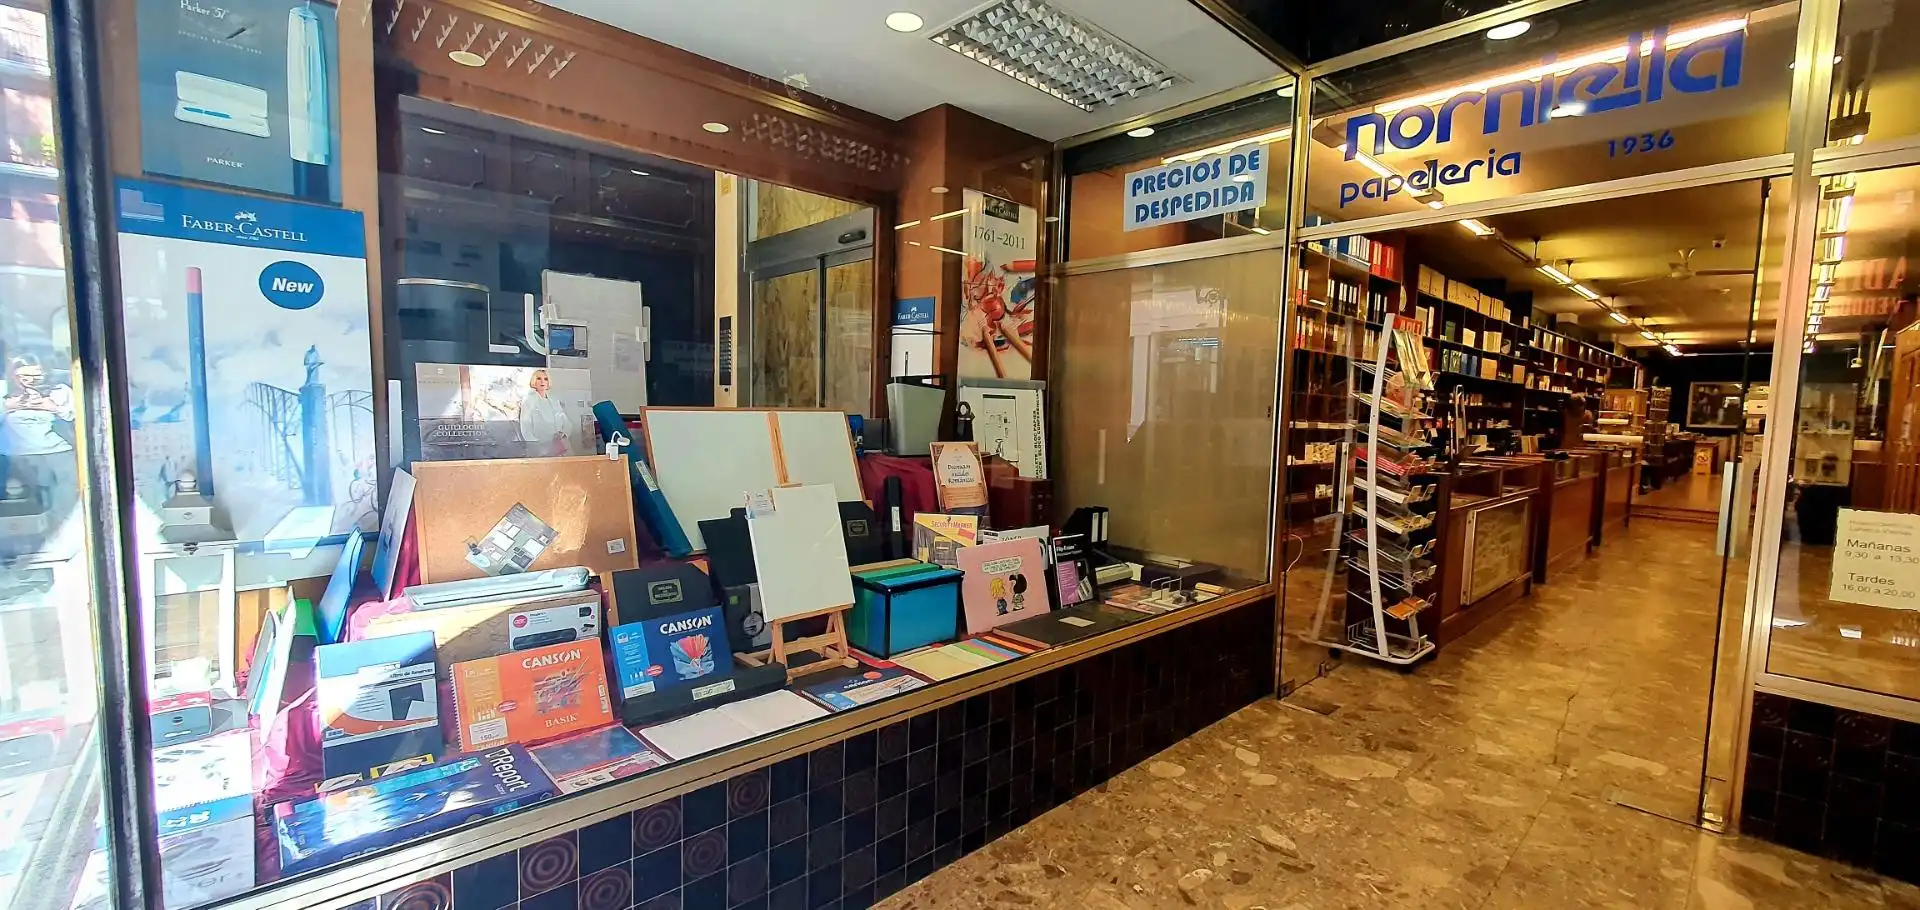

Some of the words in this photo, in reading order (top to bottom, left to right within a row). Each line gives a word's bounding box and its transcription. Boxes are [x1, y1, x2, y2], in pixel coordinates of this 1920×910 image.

[181, 0, 210, 15] Parker
[1344, 25, 1747, 160] norniella
[1608, 130, 1676, 158] 1936
[206, 156, 244, 168] PARKER
[1132, 158, 1222, 197] PRECIOS
[1229, 149, 1260, 176] DE
[1135, 181, 1255, 223] DESPEDIDA
[181, 214, 307, 242] FABER-CASTELL
[272, 277, 314, 294] New
[1847, 538, 1911, 553] Mañanas
[1848, 572, 1895, 586] Tardes
[660, 616, 712, 635] CANSON
[522, 650, 582, 669] CANSON
[545, 714, 578, 728] BASIK
[489, 754, 532, 793] Report
